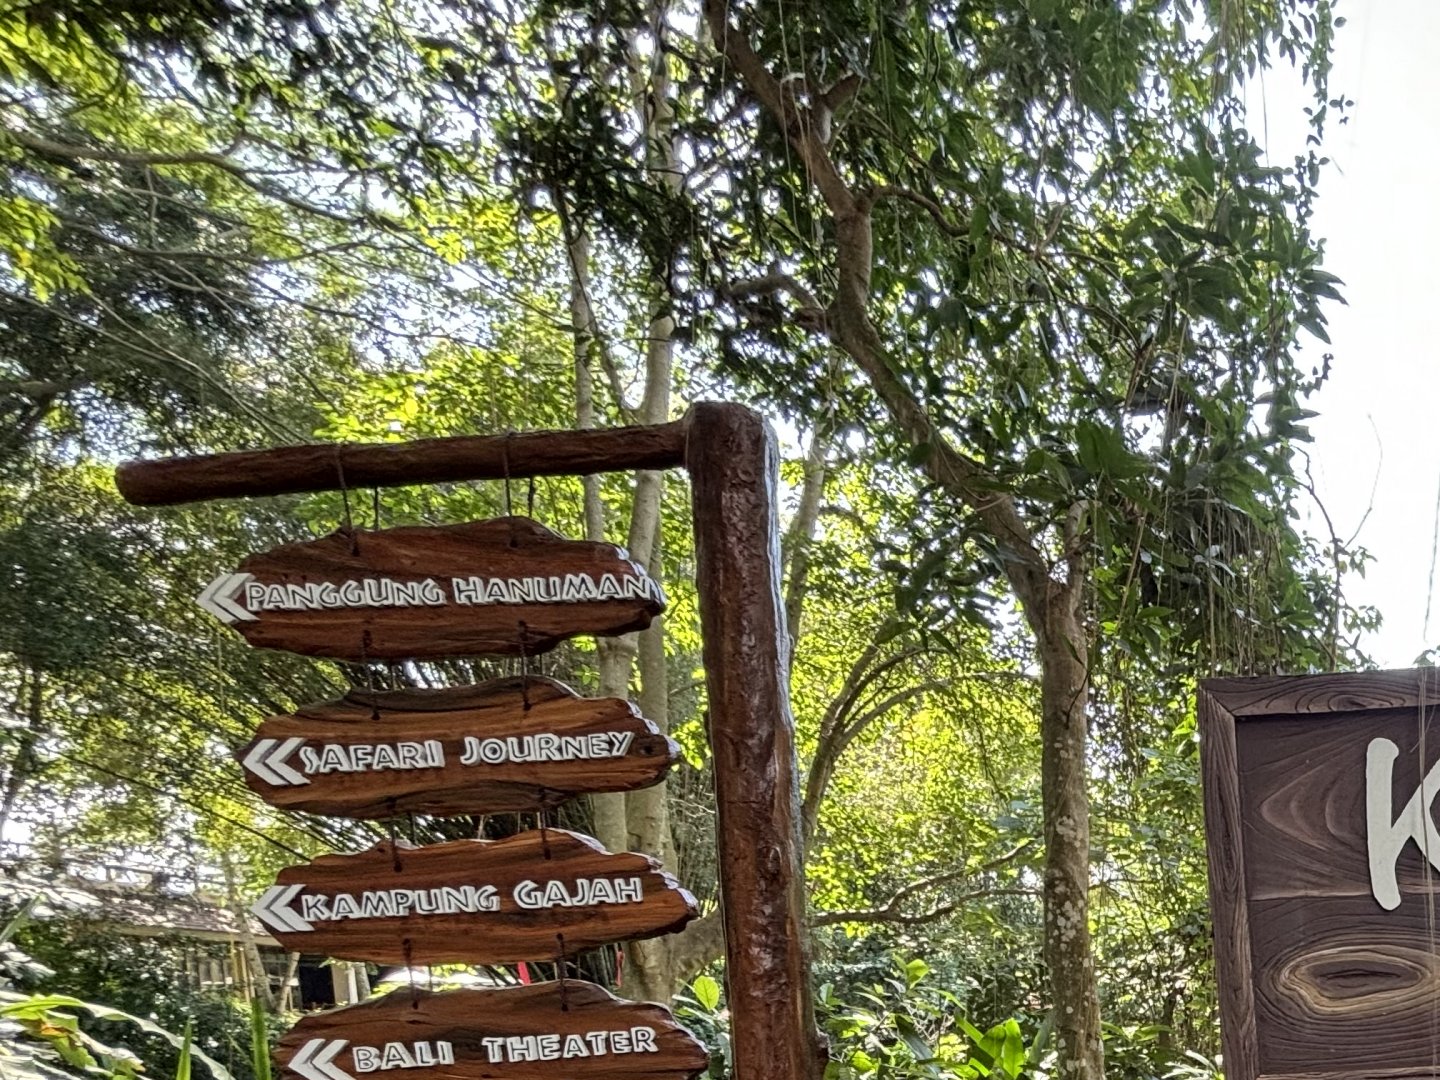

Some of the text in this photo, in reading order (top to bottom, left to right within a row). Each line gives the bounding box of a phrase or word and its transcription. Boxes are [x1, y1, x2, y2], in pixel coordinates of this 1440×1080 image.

[247, 573, 662, 611] PANGGUNG HANUMAN
[300, 732, 634, 774] SAFARI JOURNEY
[302, 877, 643, 922] KAMPUNG GAJAH
[352, 1026, 659, 1073] BALI THEATER
